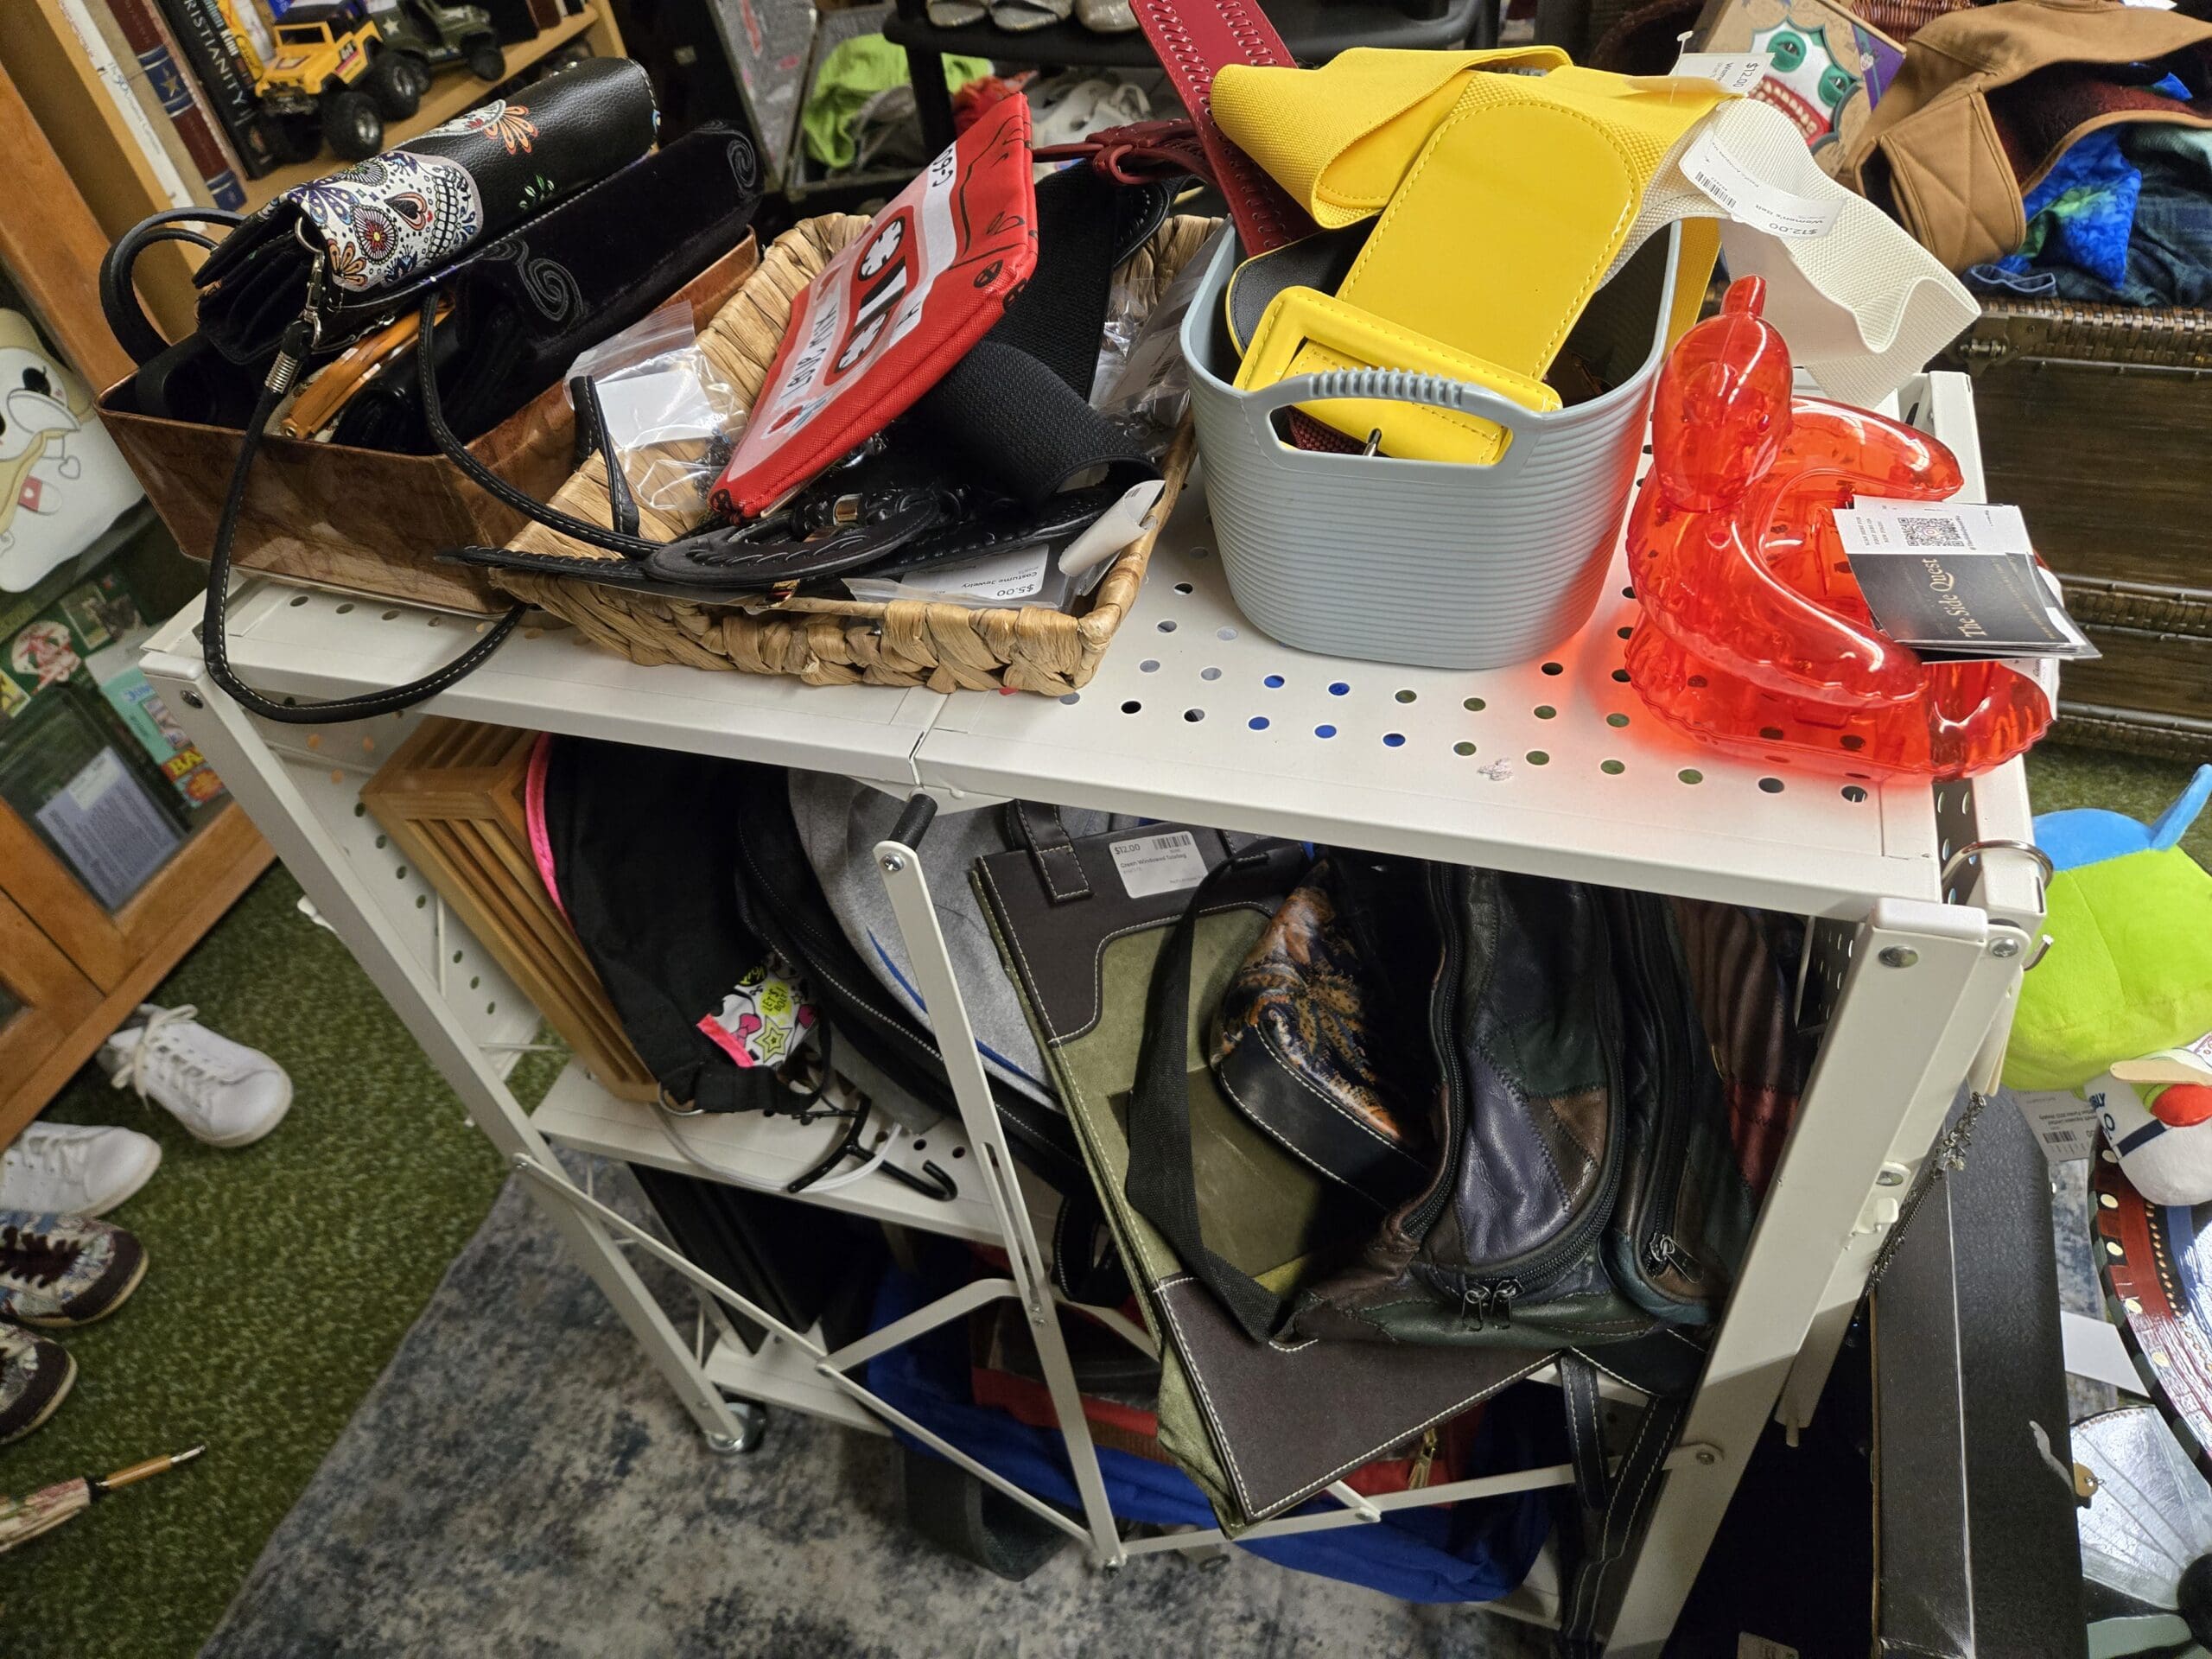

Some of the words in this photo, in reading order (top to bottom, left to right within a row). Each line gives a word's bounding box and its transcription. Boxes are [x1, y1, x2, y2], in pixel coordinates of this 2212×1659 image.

[1732, 62, 1759, 87] $12.00
[932, 147, 954, 187] C-60
[1777, 213, 1823, 224] Women's
[1769, 222, 1818, 235] $12.00
[998, 571, 1038, 584] Costume
[1922, 557, 1955, 592] Quest
[961, 580, 996, 588] Jewelry
[996, 583, 1034, 597] $5.00
[1938, 594, 1970, 616] Side
[1956, 617, 1987, 638] The
[1114, 843, 1141, 855] $12.00
[1137, 855, 1166, 865] Windowed
[762, 988, 779, 1012] LET'S
